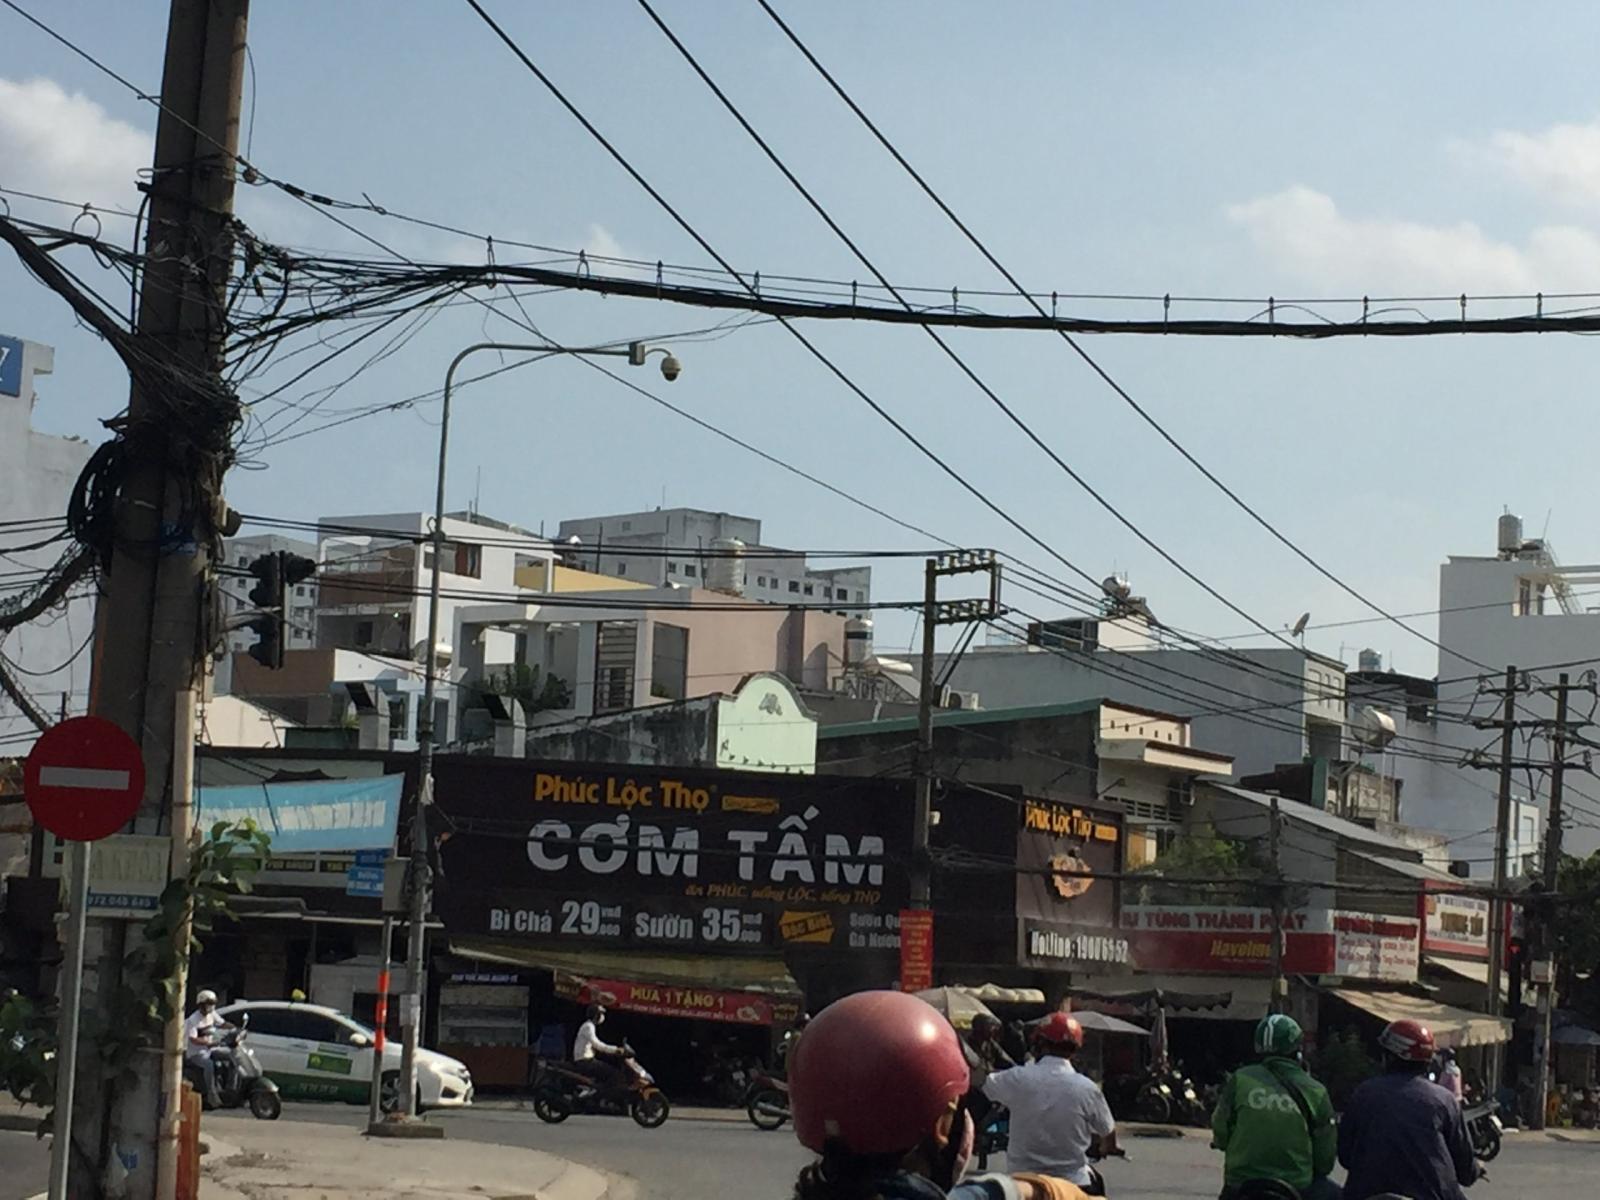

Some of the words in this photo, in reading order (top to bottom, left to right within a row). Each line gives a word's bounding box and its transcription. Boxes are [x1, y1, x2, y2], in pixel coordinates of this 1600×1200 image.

[535, 773, 599, 803] Phúc
[606, 777, 653, 811] Lộc
[659, 780, 709, 814] Thọ
[527, 813, 699, 877] CƠM
[727, 805, 884, 885] TẤM
[490, 908, 510, 931] Bì
[560, 900, 600, 935] 29
[635, 911, 694, 939] Sườn
[702, 907, 740, 942] 35
[630, 986, 661, 1004] MUA
[665, 991, 672, 1004] 1
[718, 995, 725, 1010] 1
[1247, 1087, 1300, 1114] Gra
